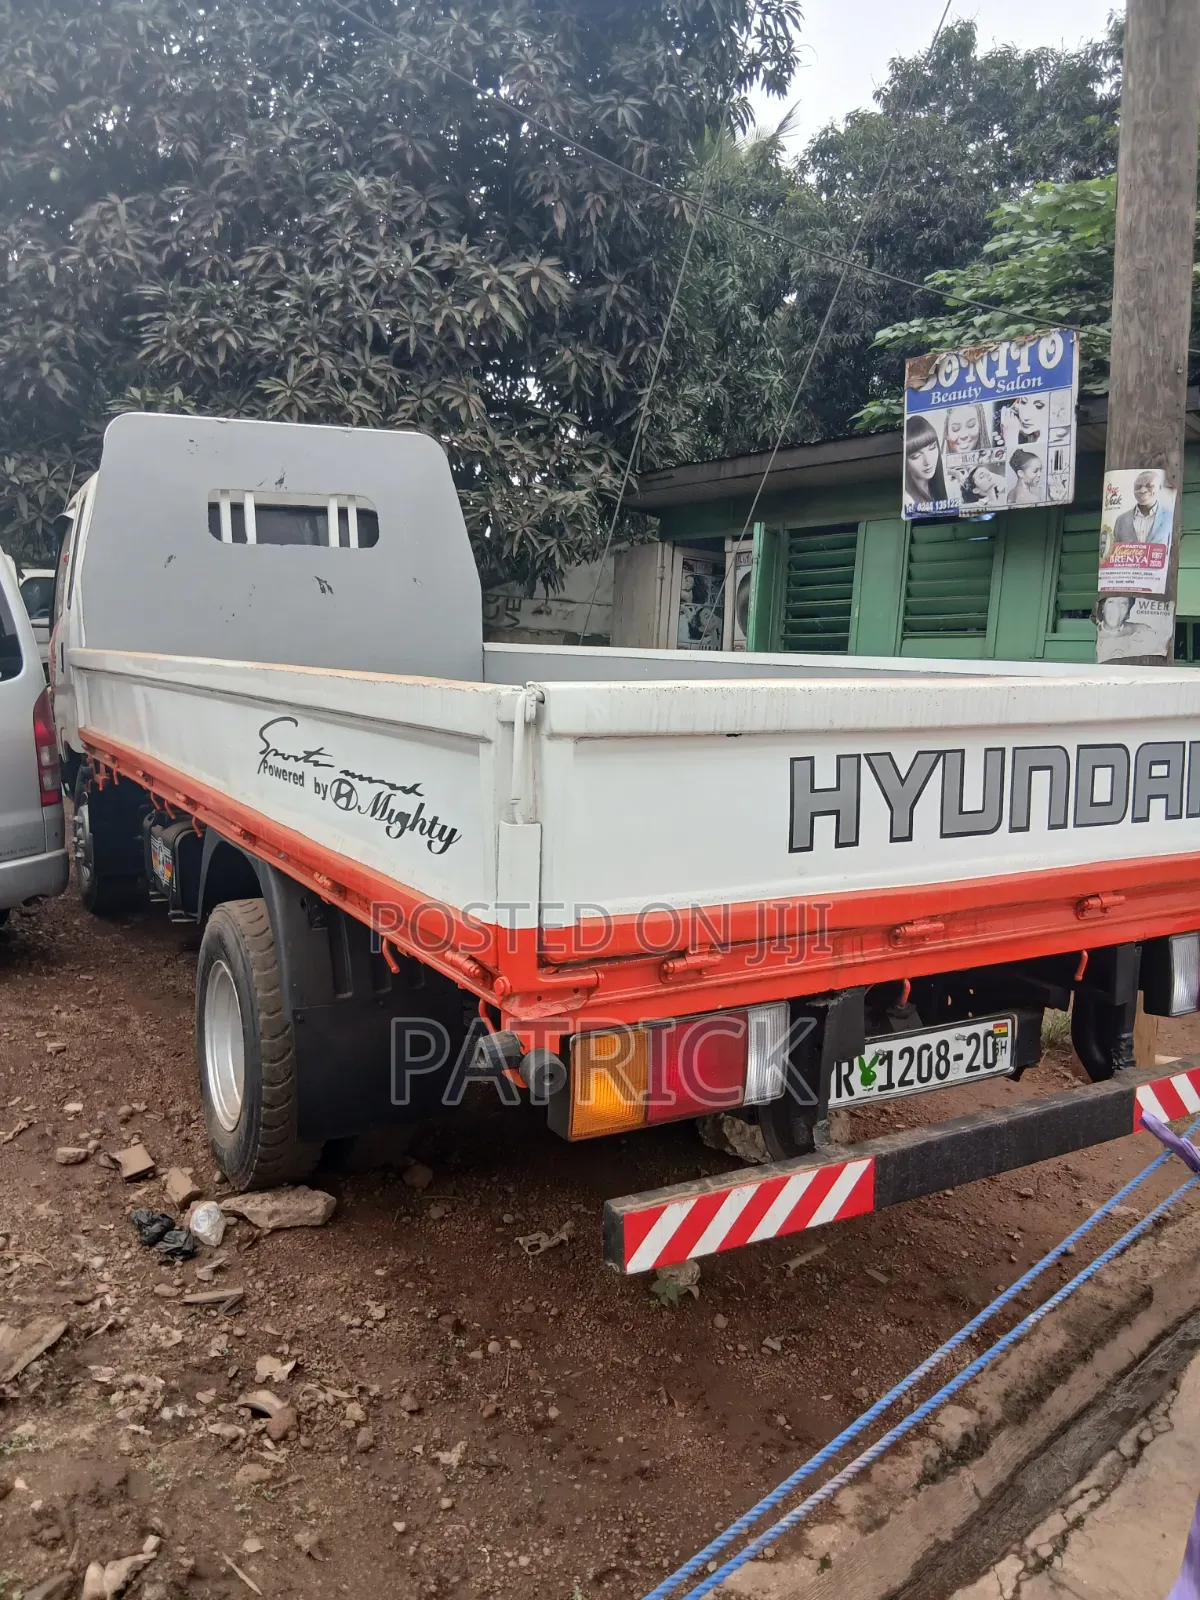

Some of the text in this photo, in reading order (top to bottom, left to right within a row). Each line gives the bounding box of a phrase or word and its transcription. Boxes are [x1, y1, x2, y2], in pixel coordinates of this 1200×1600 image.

[930, 374, 1044, 405] Beauty Salon
[1138, 600, 1170, 611] WEEK
[263, 759, 305, 788] Powered
[314, 777, 329, 800] by
[357, 790, 462, 855] Mighty
[878, 1030, 998, 1092] 1208-20
